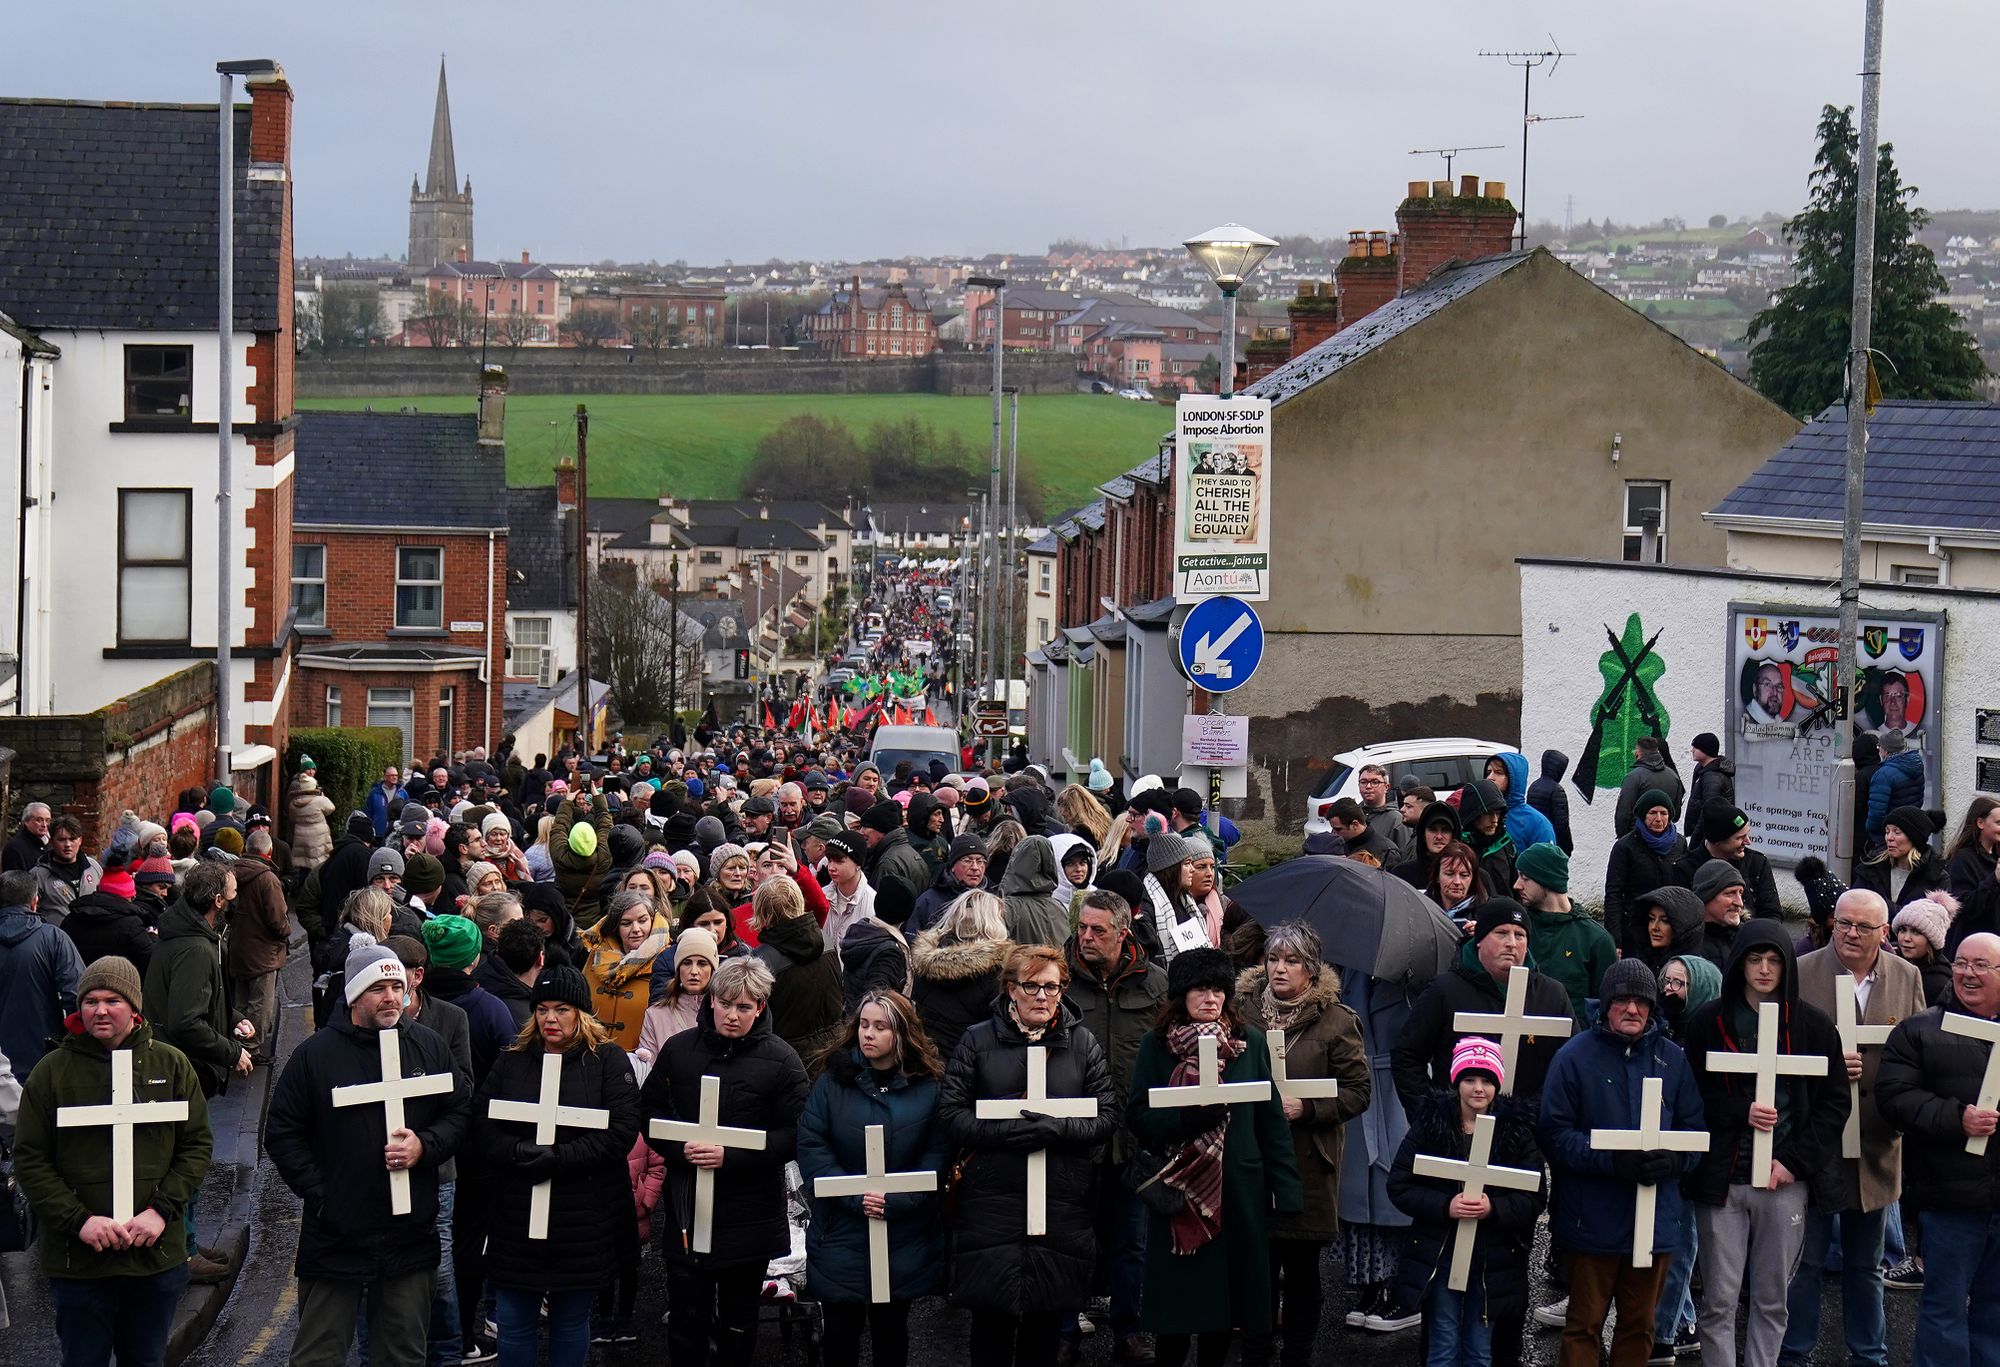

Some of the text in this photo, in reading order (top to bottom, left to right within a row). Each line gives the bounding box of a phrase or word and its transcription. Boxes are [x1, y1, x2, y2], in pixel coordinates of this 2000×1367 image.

[1183, 423, 1264, 437] Impose Abortion
[1196, 478, 1217, 486] THEY
[1196, 487, 1251, 498] CHERISH
[1195, 500, 1250, 512] ALL THE
[1194, 513, 1249, 523] CHILDREN
[1194, 524, 1249, 535] EQUALLY
[1182, 557, 1199, 567] Get
[1252, 556, 1263, 565] us
[1193, 571, 1238, 586] Aontú
[1197, 717, 1236, 727] Occasion
[1202, 727, 1231, 736] Banners
[1803, 735, 1831, 747] YO
[1789, 747, 1825, 761] ARE
[1795, 763, 1830, 777] ENTE
[1776, 773, 1820, 794] FREE
[1766, 806, 1802, 818] springs
[1749, 818, 1762, 828] he
[1765, 823, 1800, 832] graves
[1803, 826, 1815, 834] of
[1749, 835, 1828, 853] nd women spri
[1181, 929, 1194, 943] No
[379, 964, 402, 973] IONA
